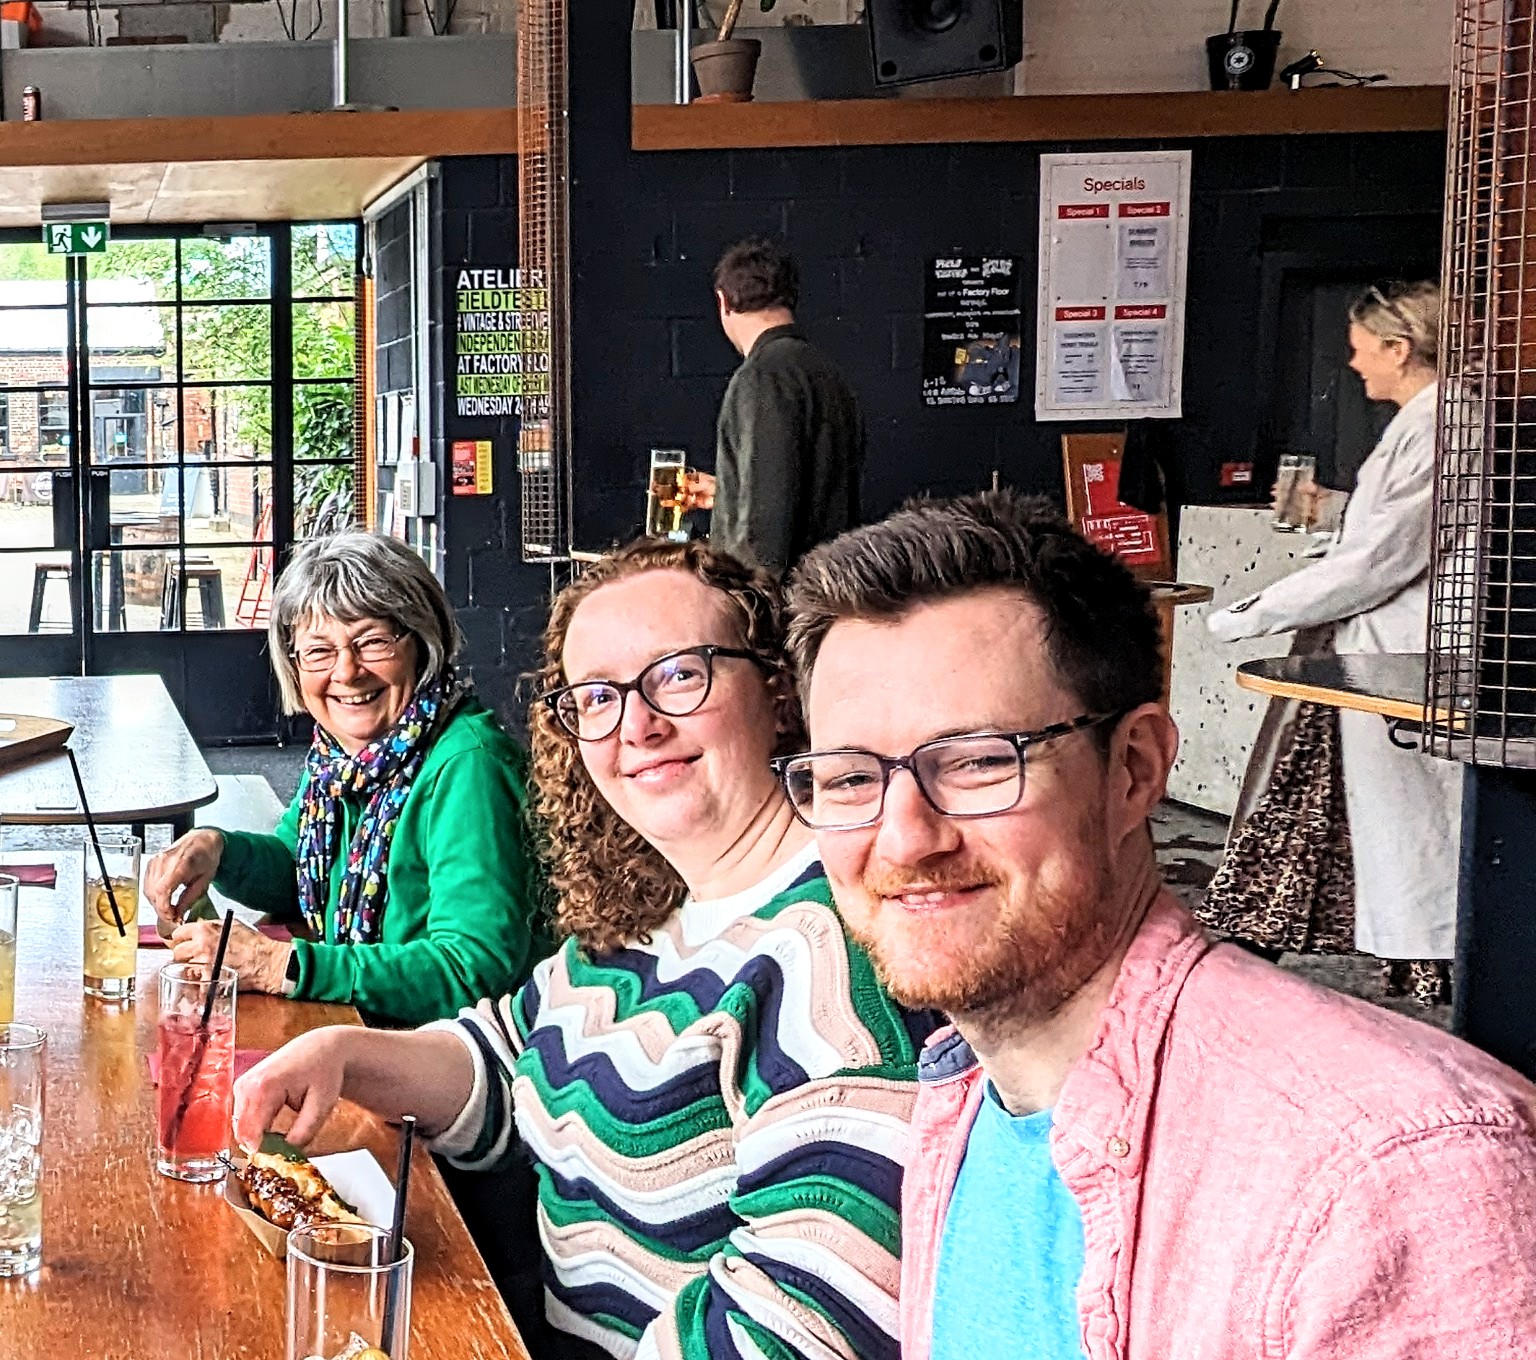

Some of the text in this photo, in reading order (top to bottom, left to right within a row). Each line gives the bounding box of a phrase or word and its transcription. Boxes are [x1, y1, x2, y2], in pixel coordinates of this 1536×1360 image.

[1084, 177, 1145, 194] Specials
[1066, 207, 1095, 217] Special
[1127, 206, 1155, 215] Special
[457, 269, 544, 289] ATELIER
[962, 288, 990, 297] Factory
[991, 287, 1010, 296] Floor
[1064, 309, 1091, 319] Special
[1124, 308, 1151, 316] Special
[463, 312, 496, 331] VINTAGE
[498, 312, 504, 330] &
[457, 355, 471, 373] AT
[473, 354, 523, 373] FACTORY
[457, 397, 513, 416] WEDNESDAY
